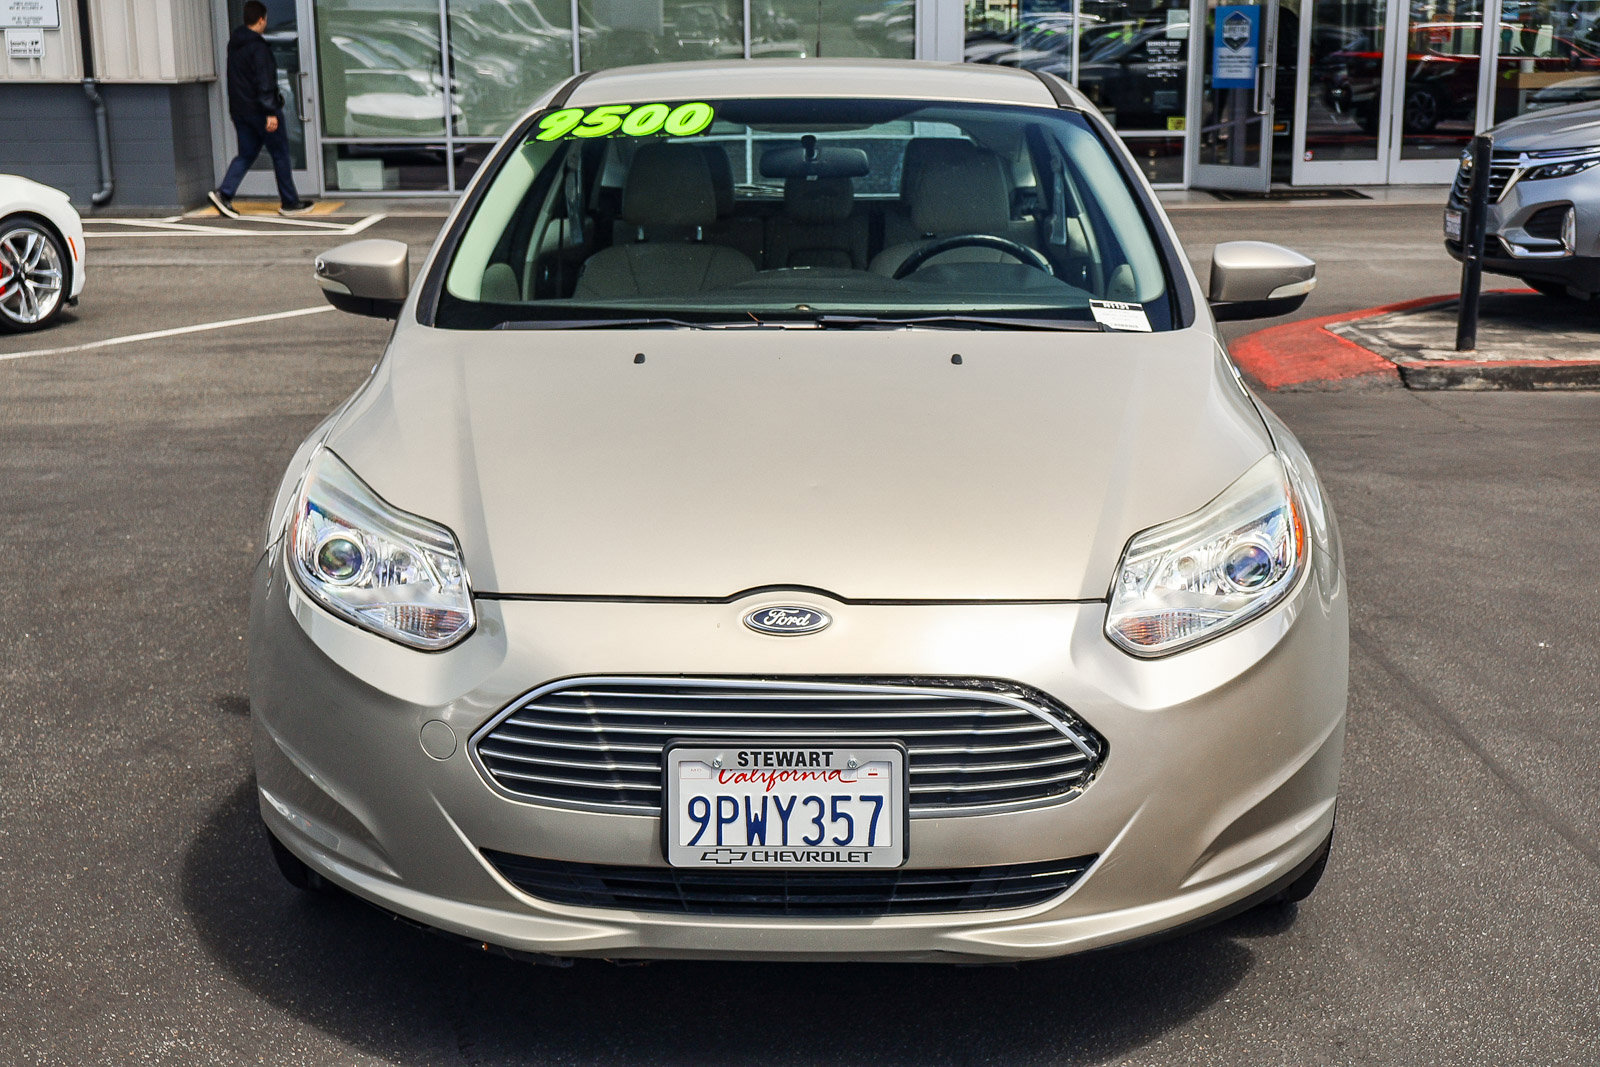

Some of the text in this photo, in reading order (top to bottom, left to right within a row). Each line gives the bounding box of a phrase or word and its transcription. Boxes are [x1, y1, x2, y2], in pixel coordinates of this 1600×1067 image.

[536, 102, 715, 141] 9500
[764, 608, 811, 626] Ford
[737, 751, 833, 767] STEWART
[718, 769, 857, 792] California
[687, 795, 883, 846] 9PWY357
[751, 851, 872, 863] CHEVROLET
